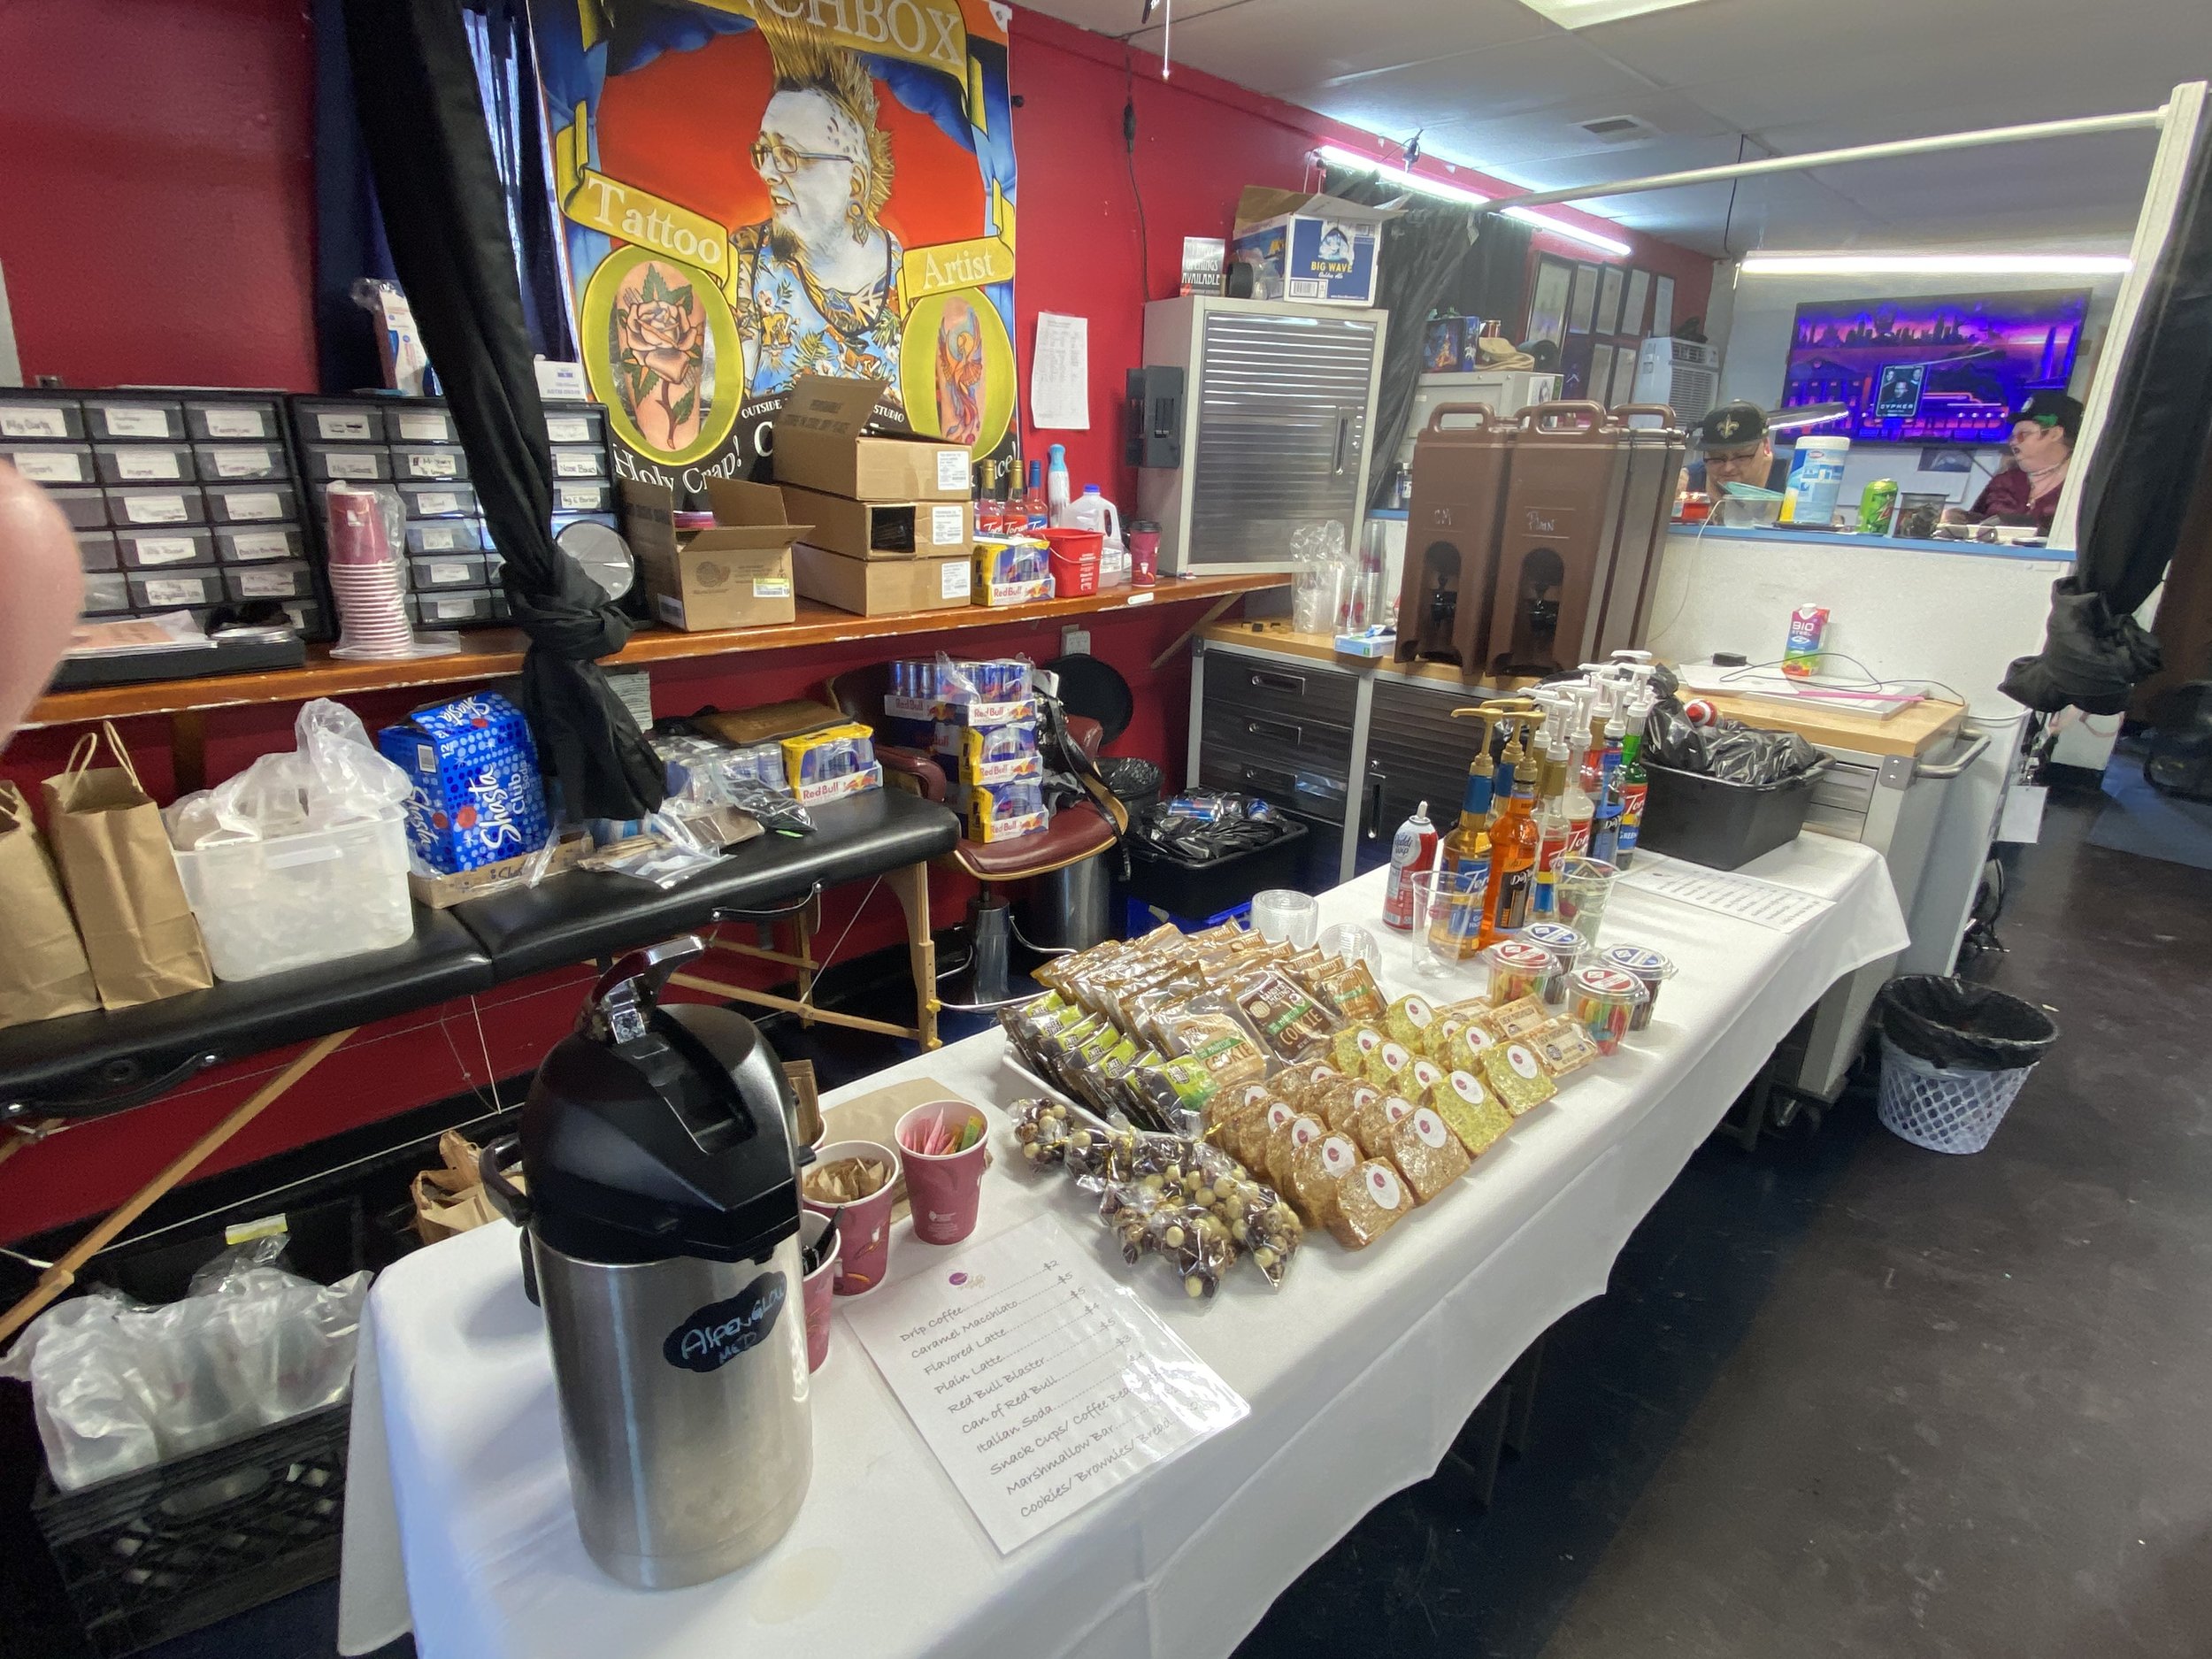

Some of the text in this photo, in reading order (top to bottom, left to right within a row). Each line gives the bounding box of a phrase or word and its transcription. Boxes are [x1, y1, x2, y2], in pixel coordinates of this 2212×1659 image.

[586, 176, 723, 266] Tattoo
[922, 248, 995, 291] Artist
[1182, 273, 1220, 285] AVAILABLE
[1310, 261, 1353, 273] BIG WAVE
[741, 399, 782, 419] OUTSIDE
[872, 403, 904, 423] STUDIO
[682, 434, 742, 494] Crap!
[994, 441, 1017, 480] ice!
[995, 586, 1022, 597] Red Bull
[1792, 621, 1814, 632] BIO
[437, 695, 490, 726] Shasta
[974, 707, 1004, 718] Red Bull
[440, 743, 453, 759] 12
[979, 765, 1008, 776] Red Bull
[468, 764, 522, 849] Shasta
[508, 773, 526, 815] Club
[803, 781, 839, 800] Red Bull
[411, 786, 439, 850] Shasta
[990, 820, 1017, 833] Red Bull
[1242, 937, 1261, 947] TOFFEE
[1294, 956, 1312, 967] TOFFEE
[1318, 959, 1338, 971] TOFFEE
[1279, 1008, 1323, 1045] COOKIE
[900, 1326, 926, 1342] Drip
[1042, 1260, 1060, 1272] $2
[963, 1300, 1018, 1333] Macchiato
[1057, 1272, 1073, 1286] $5
[924, 1286, 1087, 1376] Flavored Latte $5
[934, 1302, 1100, 1394] Plain Latte $4
[949, 1317, 1116, 1413] Red Bull Blaster $5
[991, 1403, 1004, 1419] of
[1005, 1391, 1030, 1409] Red
[1029, 1376, 1058, 1394] Bull
[977, 1425, 1020, 1453] Italian
[1022, 1405, 1053, 1428] Soda
[990, 1445, 1034, 1476] Snack
[1073, 1401, 1108, 1425] Coffee
[1107, 1386, 1131, 1402] Bea
[1006, 1425, 1114, 1495] Marshmallow Bar
[1020, 1478, 1072, 1518] Cookies/
